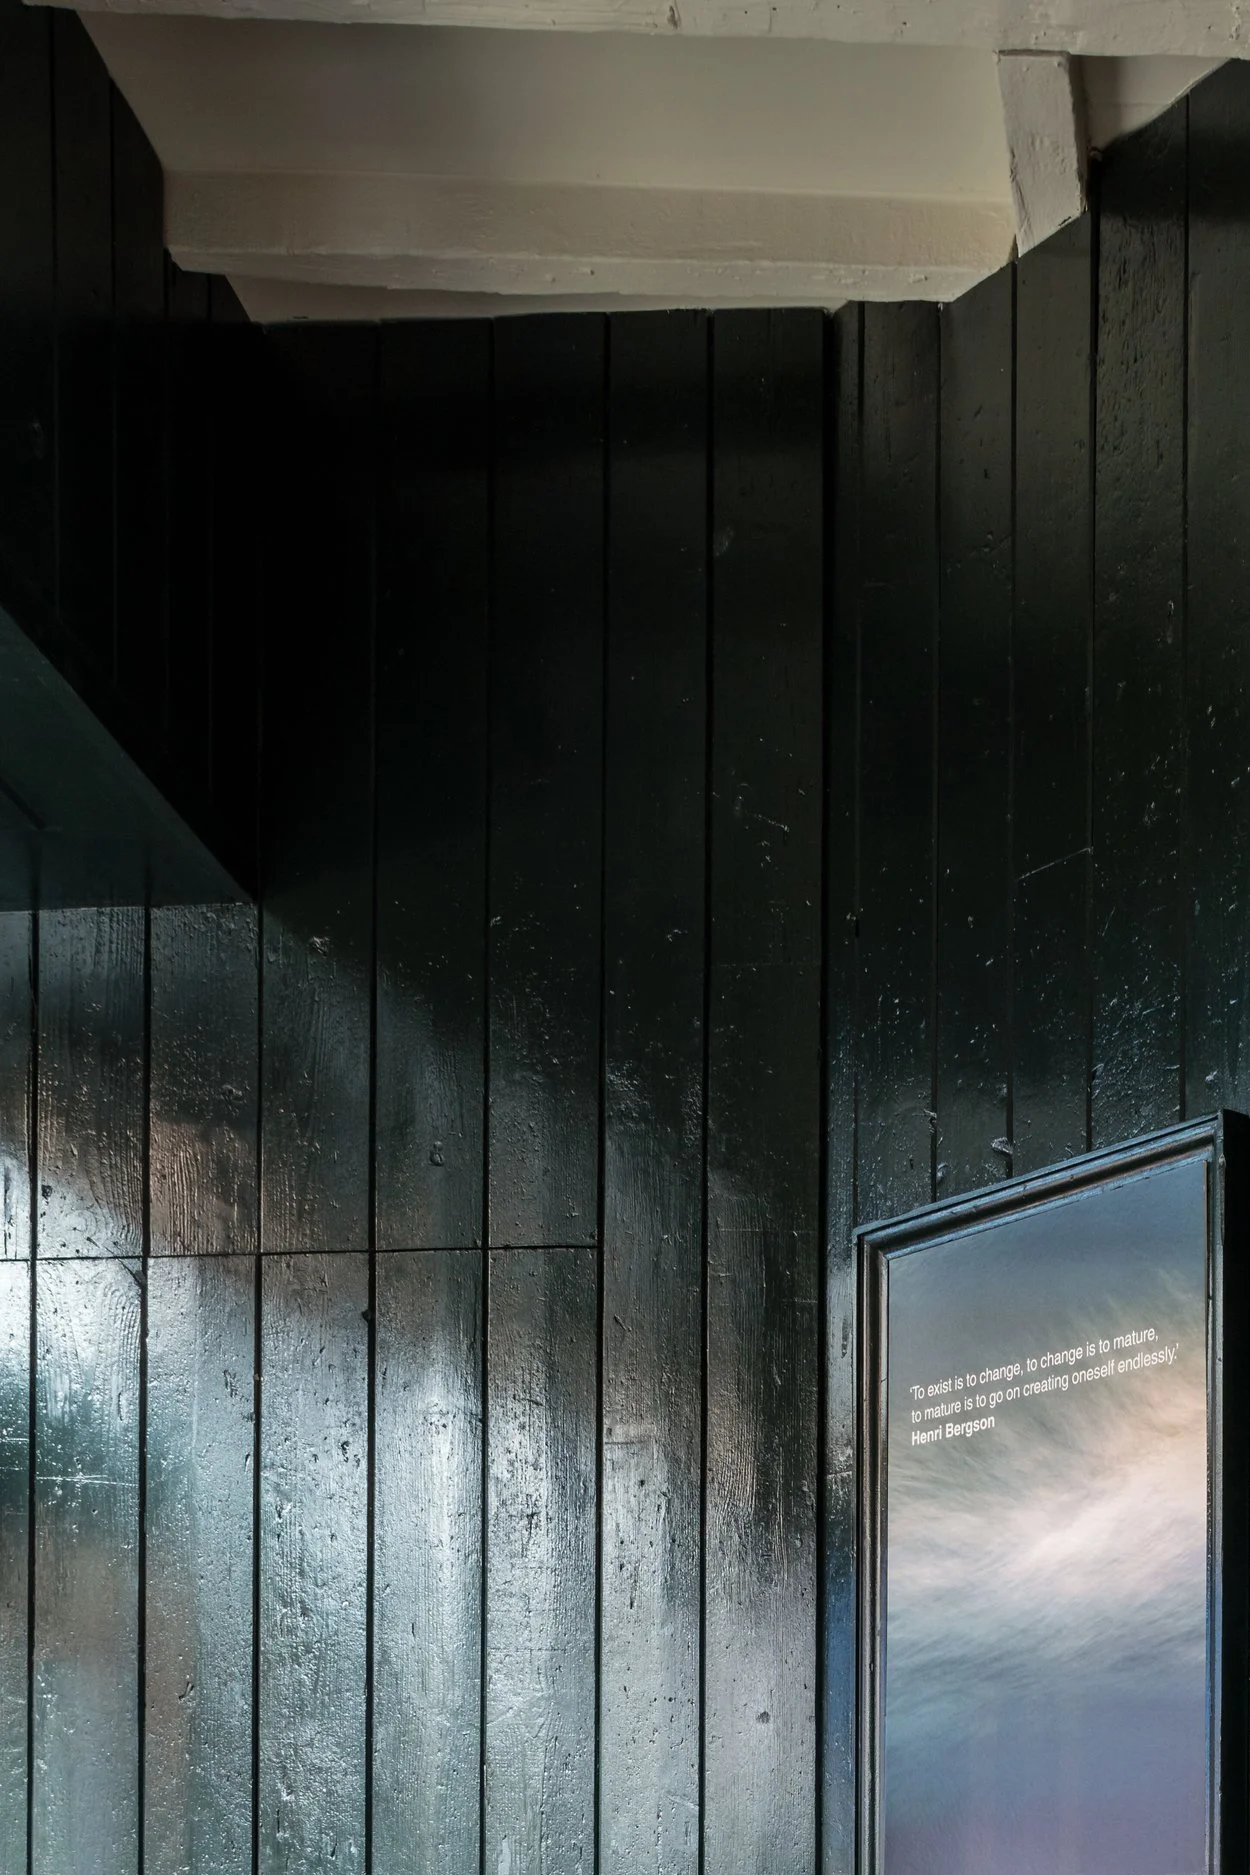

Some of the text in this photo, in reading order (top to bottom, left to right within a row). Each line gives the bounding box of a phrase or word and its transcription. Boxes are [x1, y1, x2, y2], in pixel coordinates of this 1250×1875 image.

[911, 1410, 921, 1423] to
[924, 1401, 961, 1420] mature
[964, 1396, 973, 1411] is
[976, 1394, 986, 1408] to
[989, 1391, 1003, 1408] go
[1006, 1387, 1020, 1400] on
[1023, 1375, 1069, 1397] creating
[1072, 1359, 1115, 1384] oneself
[927, 1378, 952, 1397] exist
[954, 1376, 963, 1390] is
[966, 1373, 976, 1387] to
[979, 1363, 1023, 1384] change,
[1027, 1358, 1037, 1372] to
[1040, 1347, 1083, 1368] change
[1086, 1342, 1096, 1357] is
[1099, 1339, 1110, 1353] to
[1113, 1328, 1158, 1350] mature,
[912, 1416, 995, 1446] Henri Bergson
